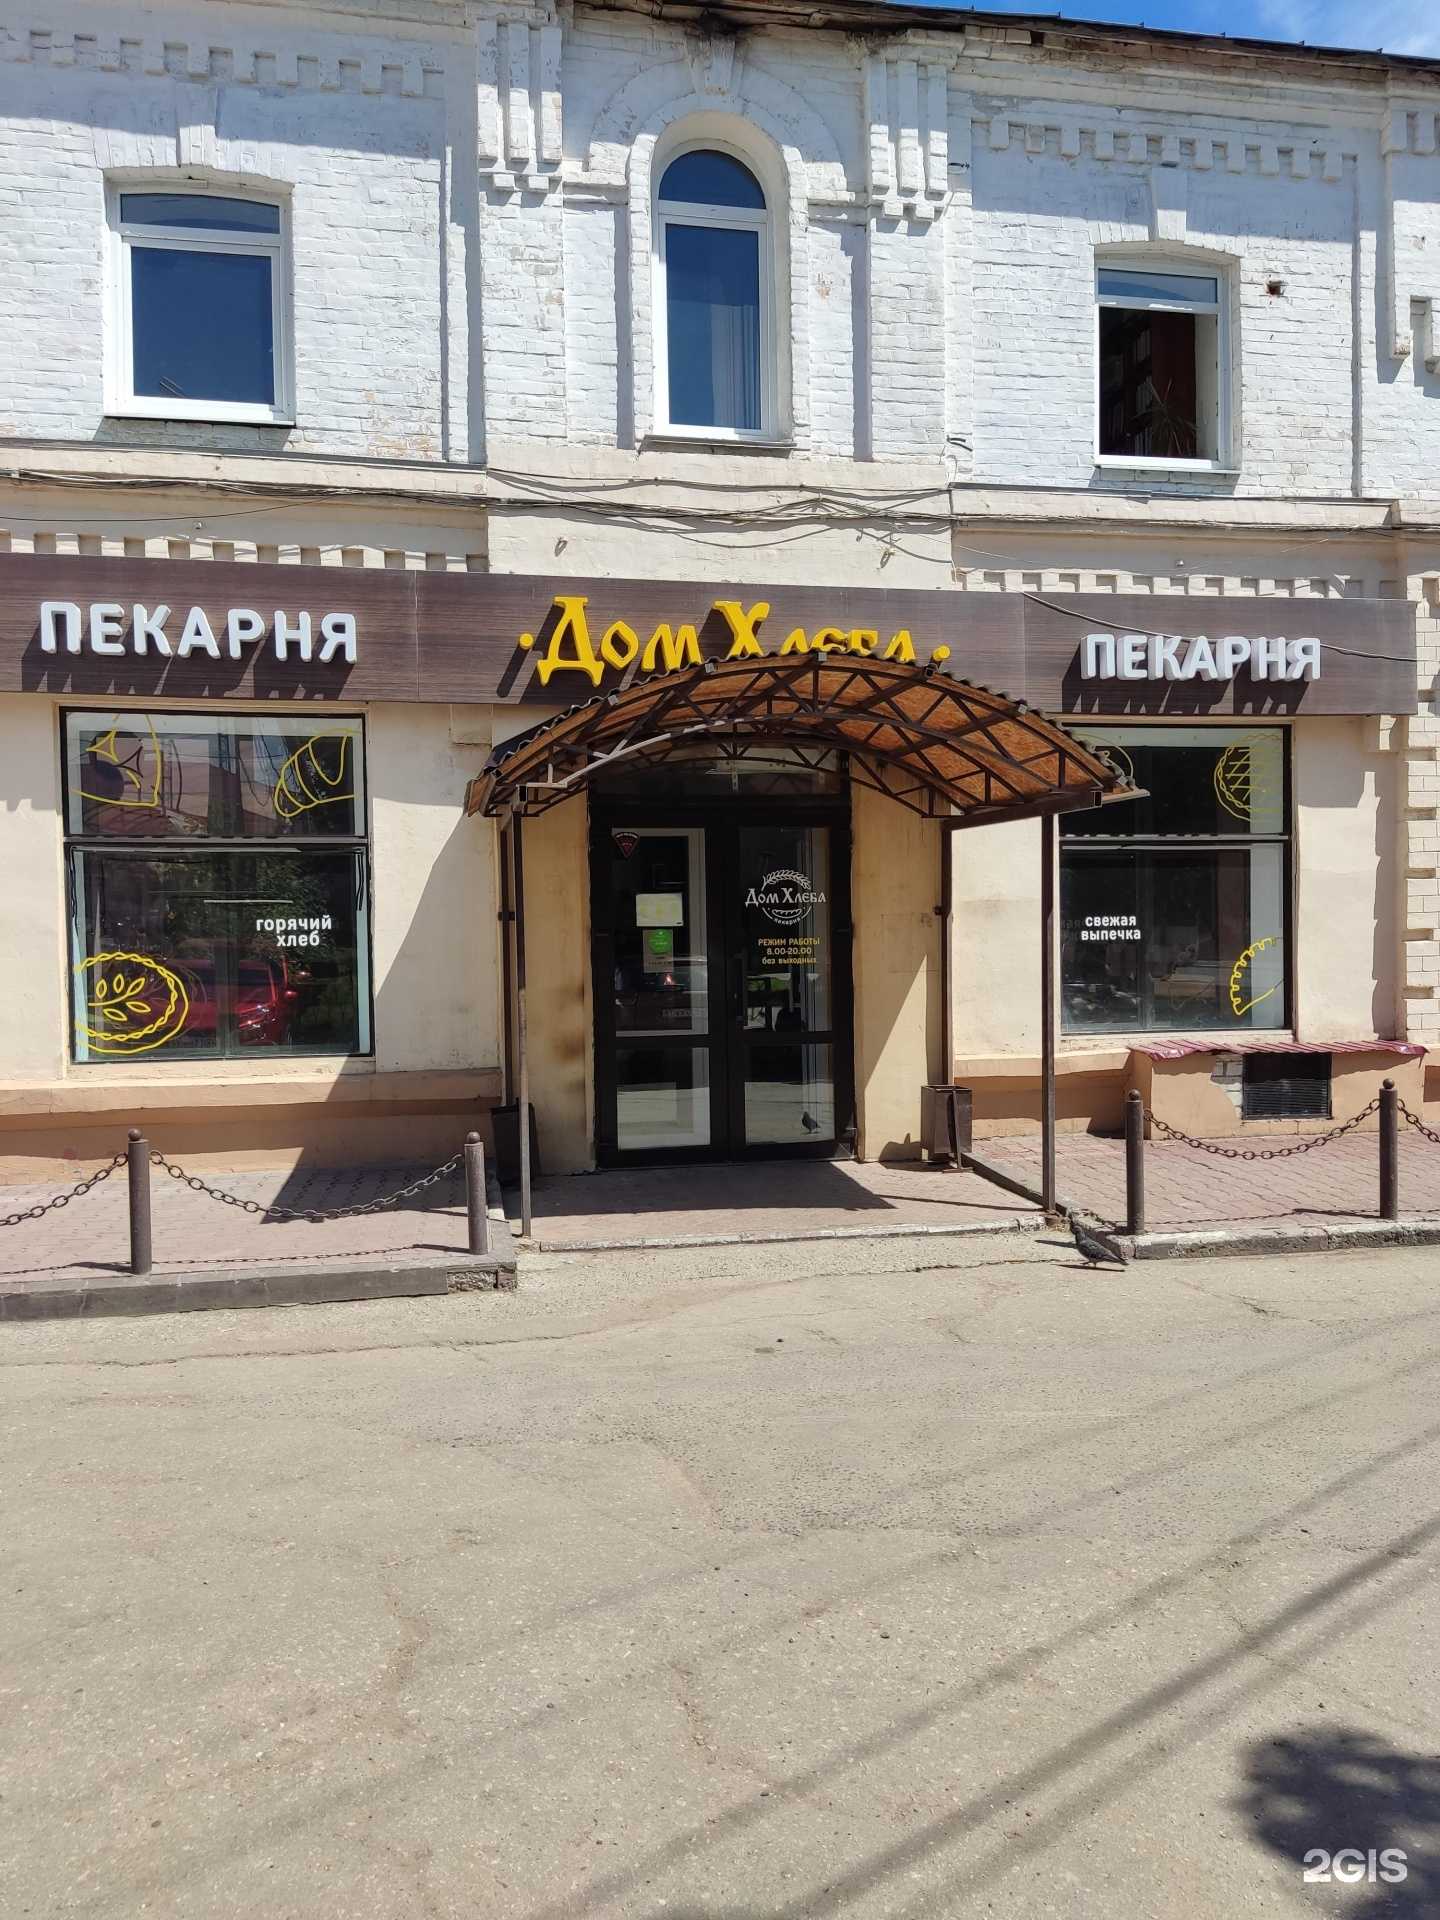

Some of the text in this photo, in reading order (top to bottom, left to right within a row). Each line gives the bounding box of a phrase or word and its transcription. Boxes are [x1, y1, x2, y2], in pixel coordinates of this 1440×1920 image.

[40, 601, 358, 664] ПЕКАРНЯ
[537, 596, 703, 687] Дом
[1080, 633, 1321, 681] ПЕКАРНЯ
[745, 887, 780, 908] Дом
[256, 914, 332, 934] горячий
[1085, 915, 1137, 927] свежая
[276, 930, 320, 947] хлеб
[758, 937, 820, 946] РЕЖИМ РАБОТЫ
[1081, 929, 1142, 941] выпечка
[761, 956, 817, 965] без выходных
